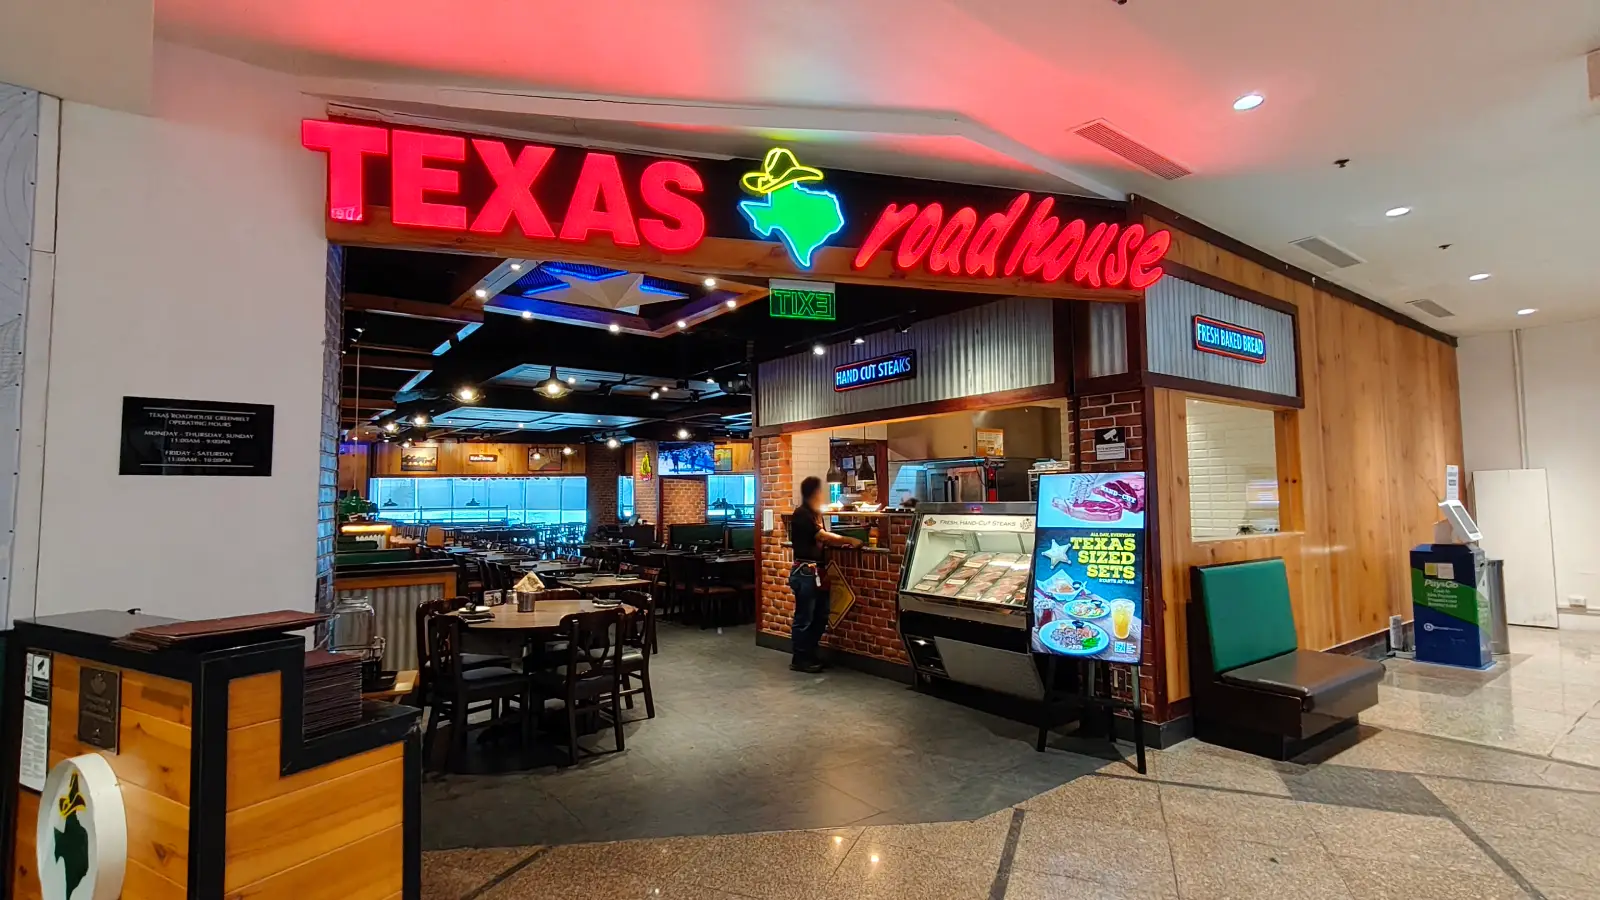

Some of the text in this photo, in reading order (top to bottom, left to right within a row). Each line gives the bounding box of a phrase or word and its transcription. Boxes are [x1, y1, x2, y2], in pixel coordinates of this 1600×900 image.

[302, 119, 705, 251] TEXAS
[855, 193, 1171, 287] roadhouse
[1197, 323, 1264, 355] FRESH BAKED BREAD
[836, 357, 911, 385] HAND CUT STEAKS
[170, 413, 212, 421] ROADHOUSE
[1070, 537, 1136, 551] TEXAS
[1078, 550, 1135, 565] SIZED
[1086, 564, 1135, 579] SETS
